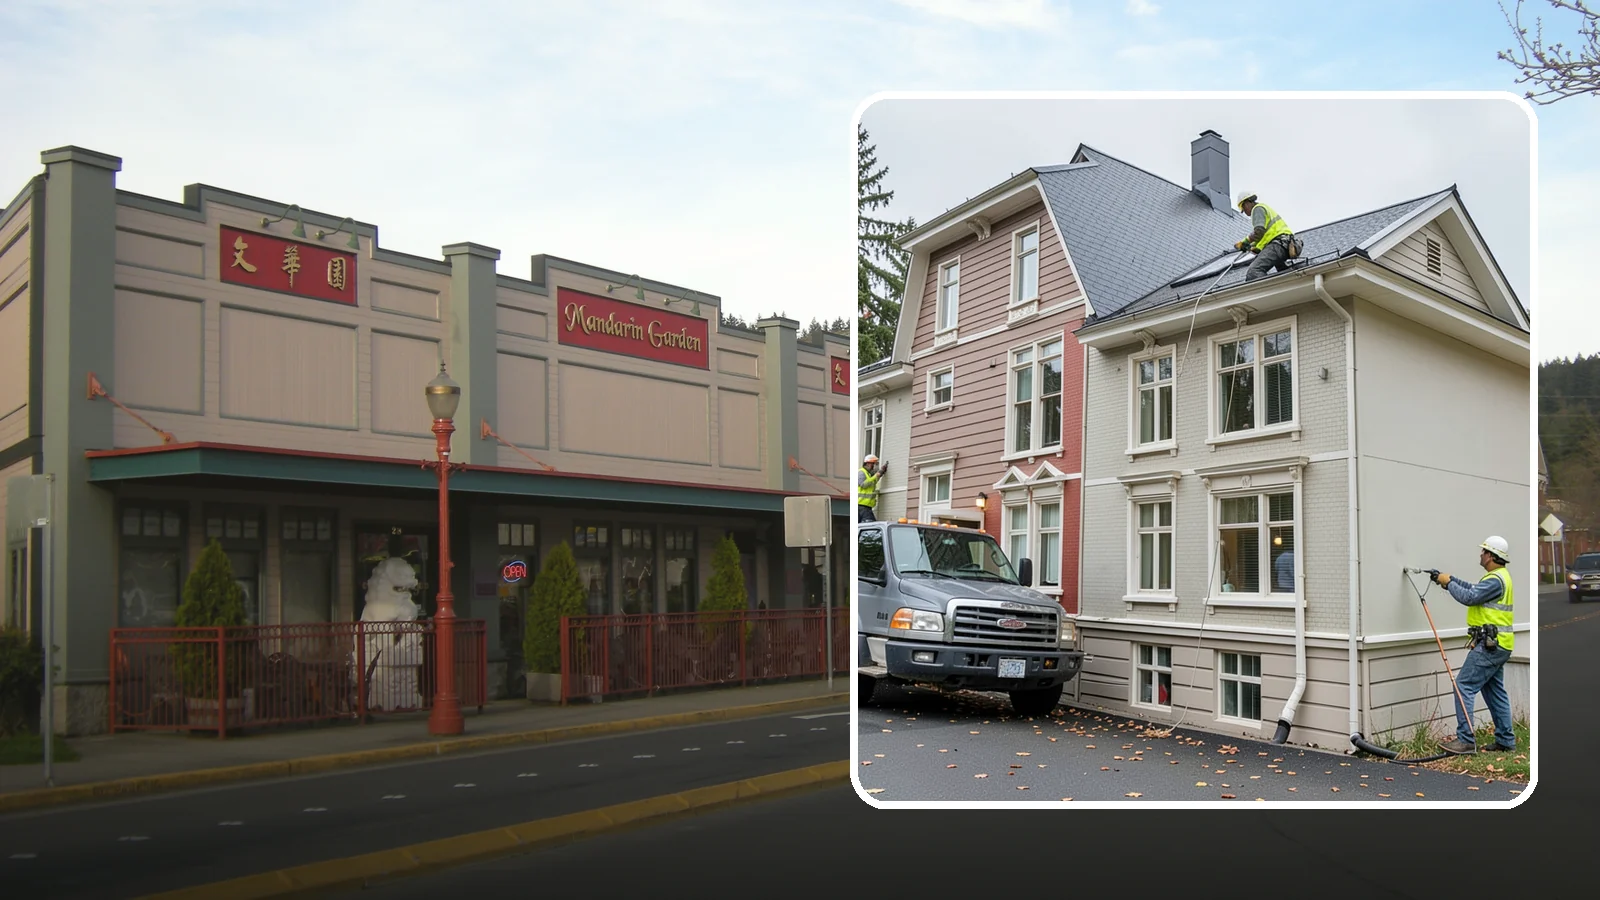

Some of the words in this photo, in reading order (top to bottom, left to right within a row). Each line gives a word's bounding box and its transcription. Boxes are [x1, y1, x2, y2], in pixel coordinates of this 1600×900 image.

[564, 302, 644, 341] Mandarin
[648, 320, 702, 352] Garden
[503, 565, 527, 578] OPEN
